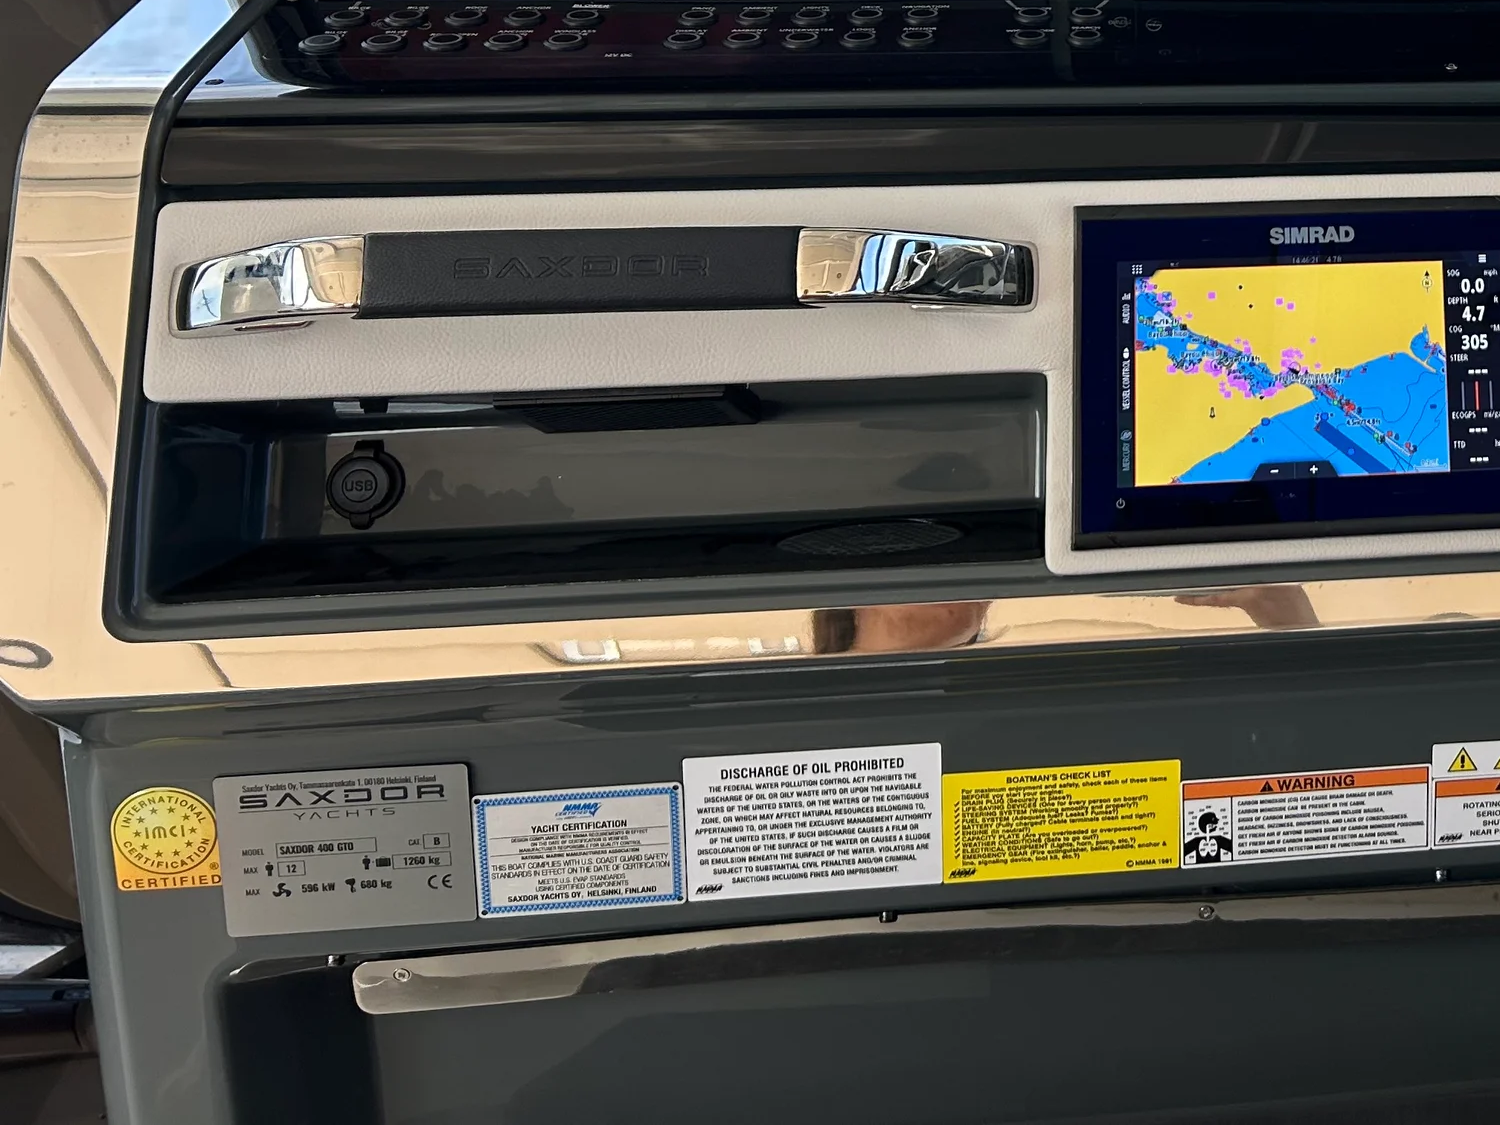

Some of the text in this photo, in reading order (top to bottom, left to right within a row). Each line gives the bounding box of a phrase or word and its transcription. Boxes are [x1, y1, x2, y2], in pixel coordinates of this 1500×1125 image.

[1270, 226, 1354, 244] SIMRAD
[453, 254, 710, 279] SAXDOR
[1461, 278, 1485, 294] 0.0
[1462, 306, 1485, 321] 4.7
[1449, 325, 1462, 333] COG
[1461, 334, 1488, 350] 305
[344, 479, 374, 492] USB
[721, 758, 904, 779] DISCHARGE OF OIL PROHIBITED
[724, 784, 753, 792] FEDERAL
[781, 780, 817, 788] POLLUTION
[867, 774, 902, 782] PROHIBITS
[1006, 770, 1111, 784] BOATMAN'S CHECK LIST
[1277, 774, 1355, 791] WARNING
[239, 784, 444, 809] SAXDOR
[121, 796, 206, 828] INTERNATIONAL
[293, 807, 395, 820] YACHTS
[531, 820, 627, 833] YACHT CERTIFICATION
[1470, 829, 1492, 837] NEAR
[280, 845, 314, 855] SAXDOR
[318, 843, 334, 853] 400
[337, 842, 354, 852] GTO
[434, 837, 440, 845] B
[124, 838, 210, 869] CERTIFICATION
[403, 855, 440, 866] 1260 kg
[244, 864, 297, 875] MAX 12
[122, 874, 221, 889] CERTIFIED
[246, 882, 335, 896] MAX 596 kW
[361, 880, 392, 890] 680 kg
[508, 894, 538, 903] SAXDOR
[540, 892, 569, 901] YACHTS
[625, 886, 657, 894] FINLAND
